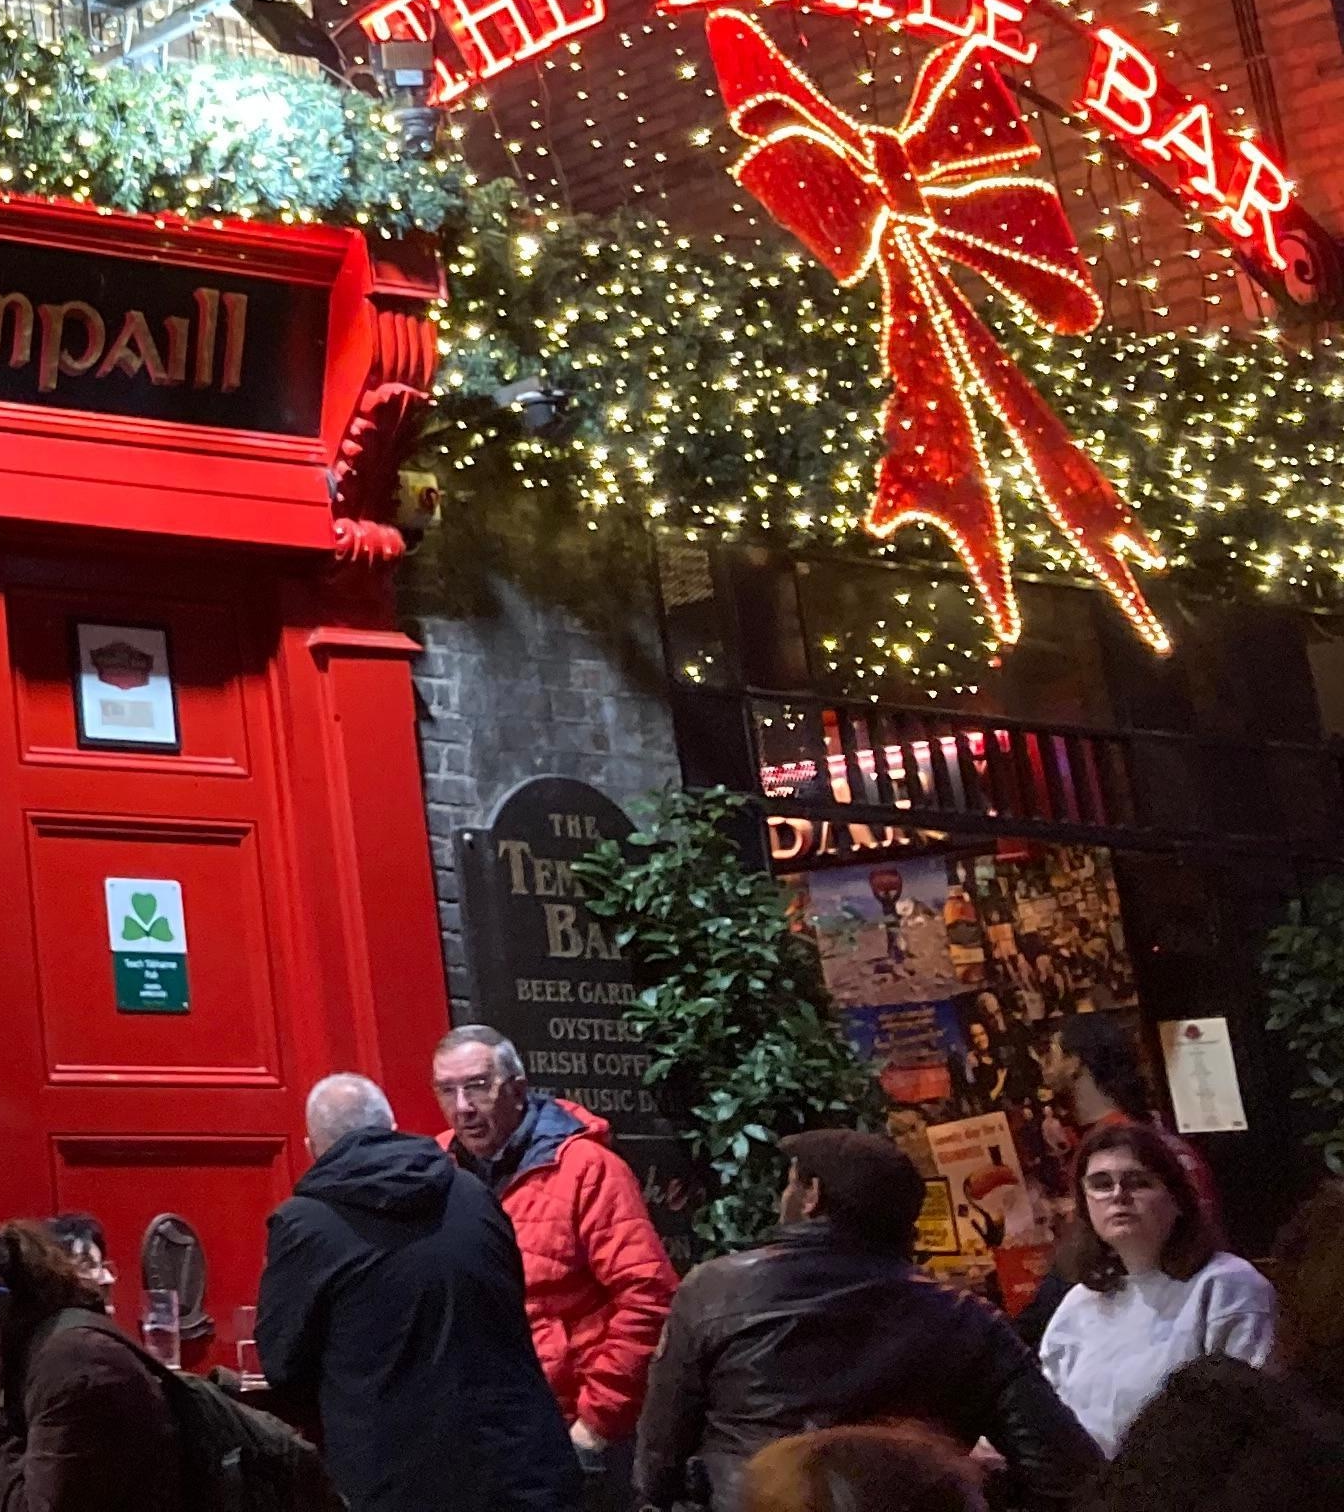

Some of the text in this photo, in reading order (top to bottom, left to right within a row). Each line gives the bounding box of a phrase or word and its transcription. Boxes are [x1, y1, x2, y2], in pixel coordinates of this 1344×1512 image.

[1082, 28, 1297, 270] BAR
[549, 814, 599, 839] THE
[499, 840, 585, 895] TEM
[545, 903, 623, 960] BA
[516, 978, 636, 1004] BEER GARD
[528, 1051, 653, 1076] IRISH COFF
